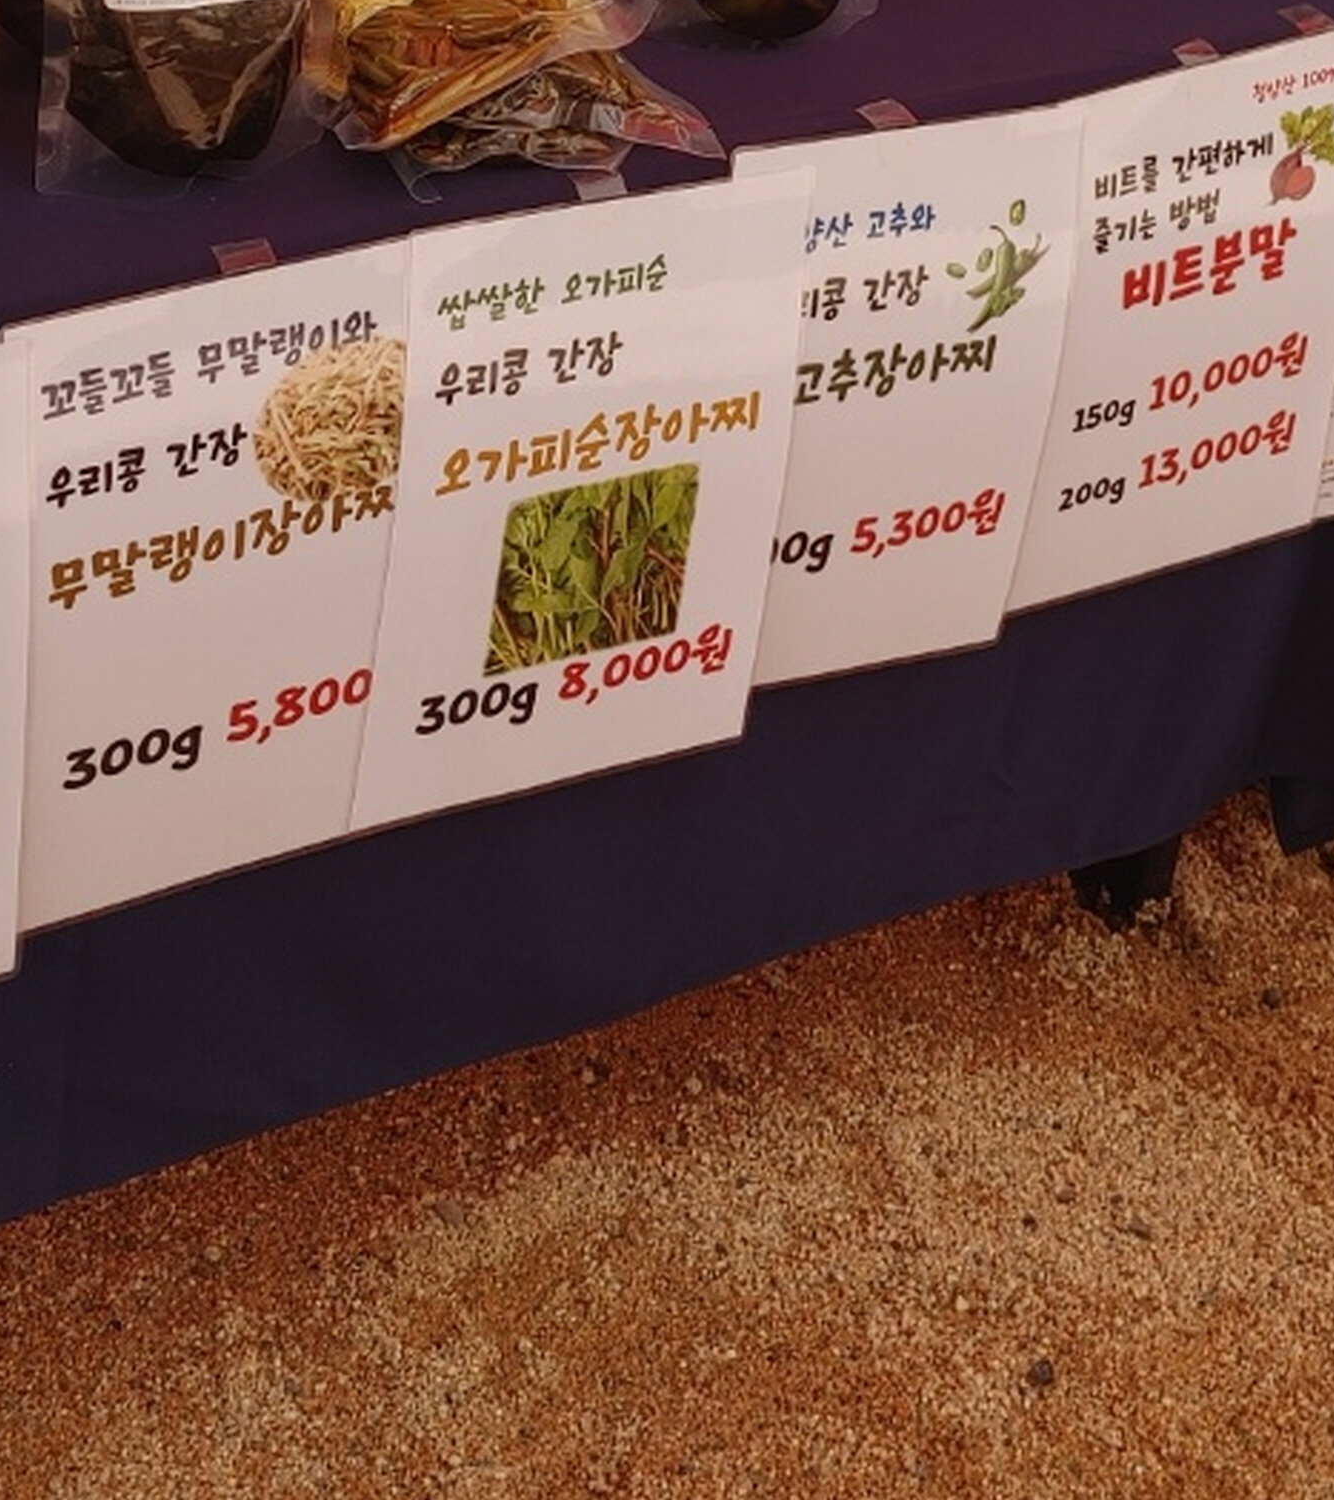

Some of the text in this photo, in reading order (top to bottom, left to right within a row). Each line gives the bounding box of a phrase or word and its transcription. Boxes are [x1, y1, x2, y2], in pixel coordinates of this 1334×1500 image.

[1095, 132, 1274, 201] 비트를 간편하게
[867, 203, 936, 239] 고추와
[1093, 188, 1220, 254] 즐기는 방법
[437, 253, 669, 331] 쌉쌀한 오가피순
[863, 266, 929, 313] 간장
[1122, 217, 1296, 309] 비트분말
[42, 310, 378, 420] 꼬들꼬들 무말랭이와
[435, 331, 623, 406] 우리콩 간장
[794, 336, 998, 405] 고추장아찌
[1071, 332, 1308, 433] 150g 10,000원
[46, 422, 248, 508] 우리콩 간장
[435, 391, 762, 497] 오가피순장아찌
[1058, 410, 1296, 511] 200g 13,000원
[850, 488, 1005, 558] 5,300원
[415, 623, 734, 736] 300g 8,000원
[63, 724, 203, 790] 300g
